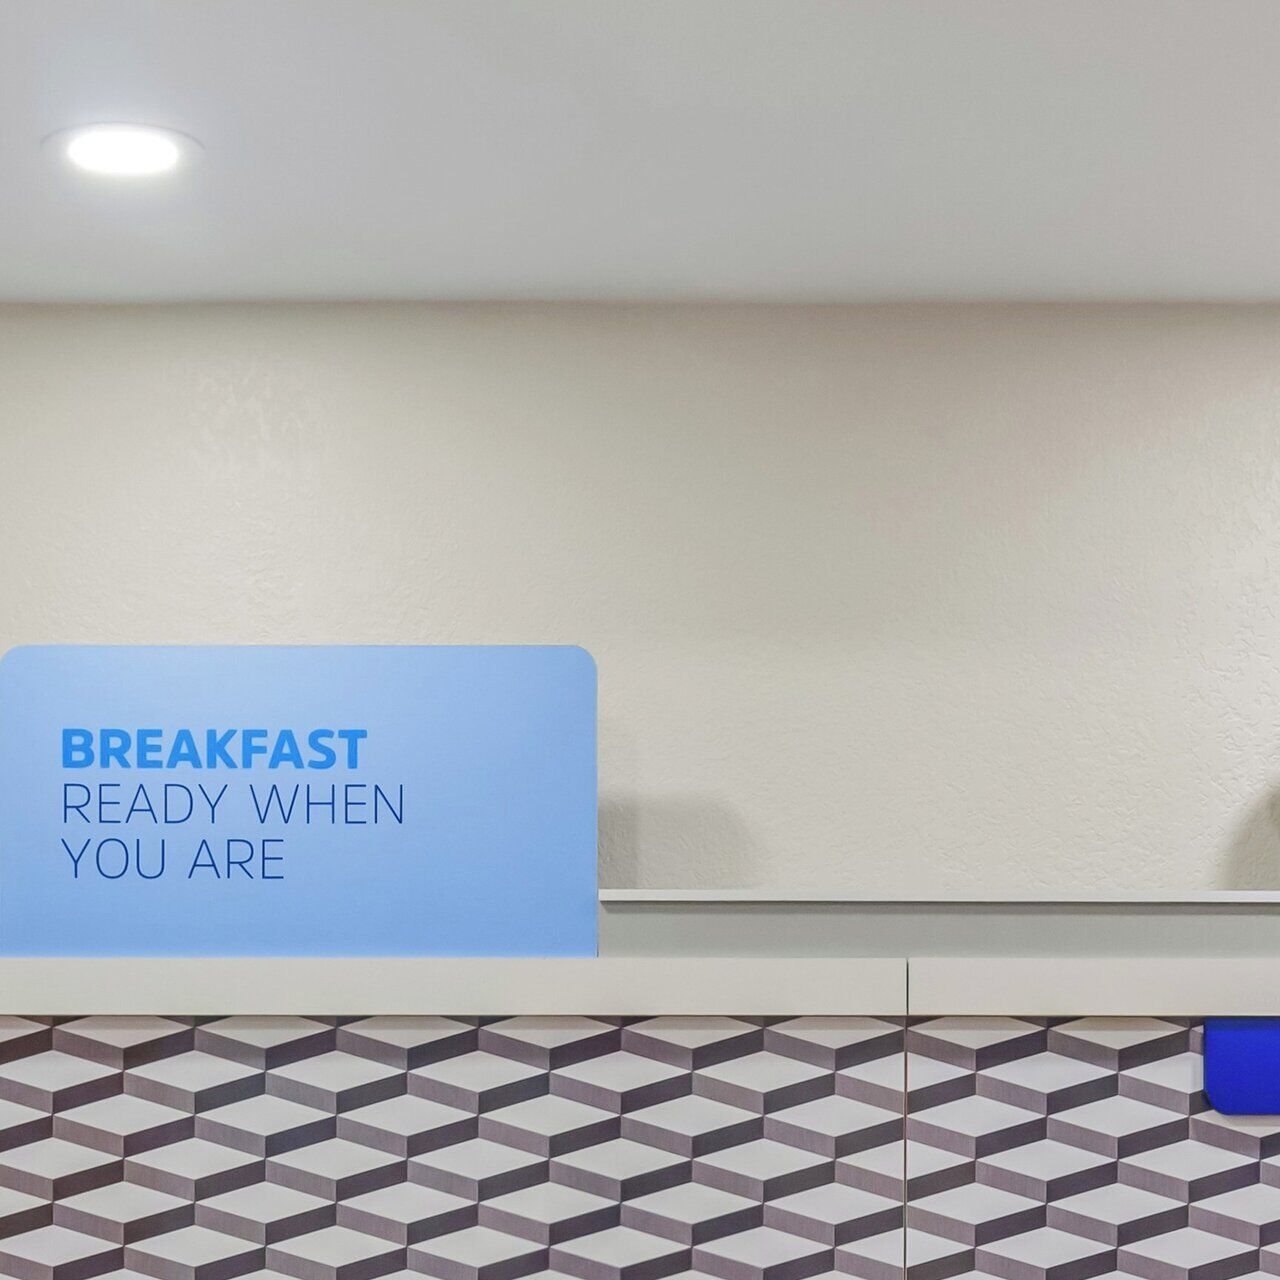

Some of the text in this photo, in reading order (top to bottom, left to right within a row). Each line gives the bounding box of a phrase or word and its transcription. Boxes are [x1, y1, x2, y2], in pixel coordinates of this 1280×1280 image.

[61, 728, 368, 770] BREAKFAST
[62, 783, 405, 825] READY WHEN
[61, 837, 285, 880] YOU ARE
